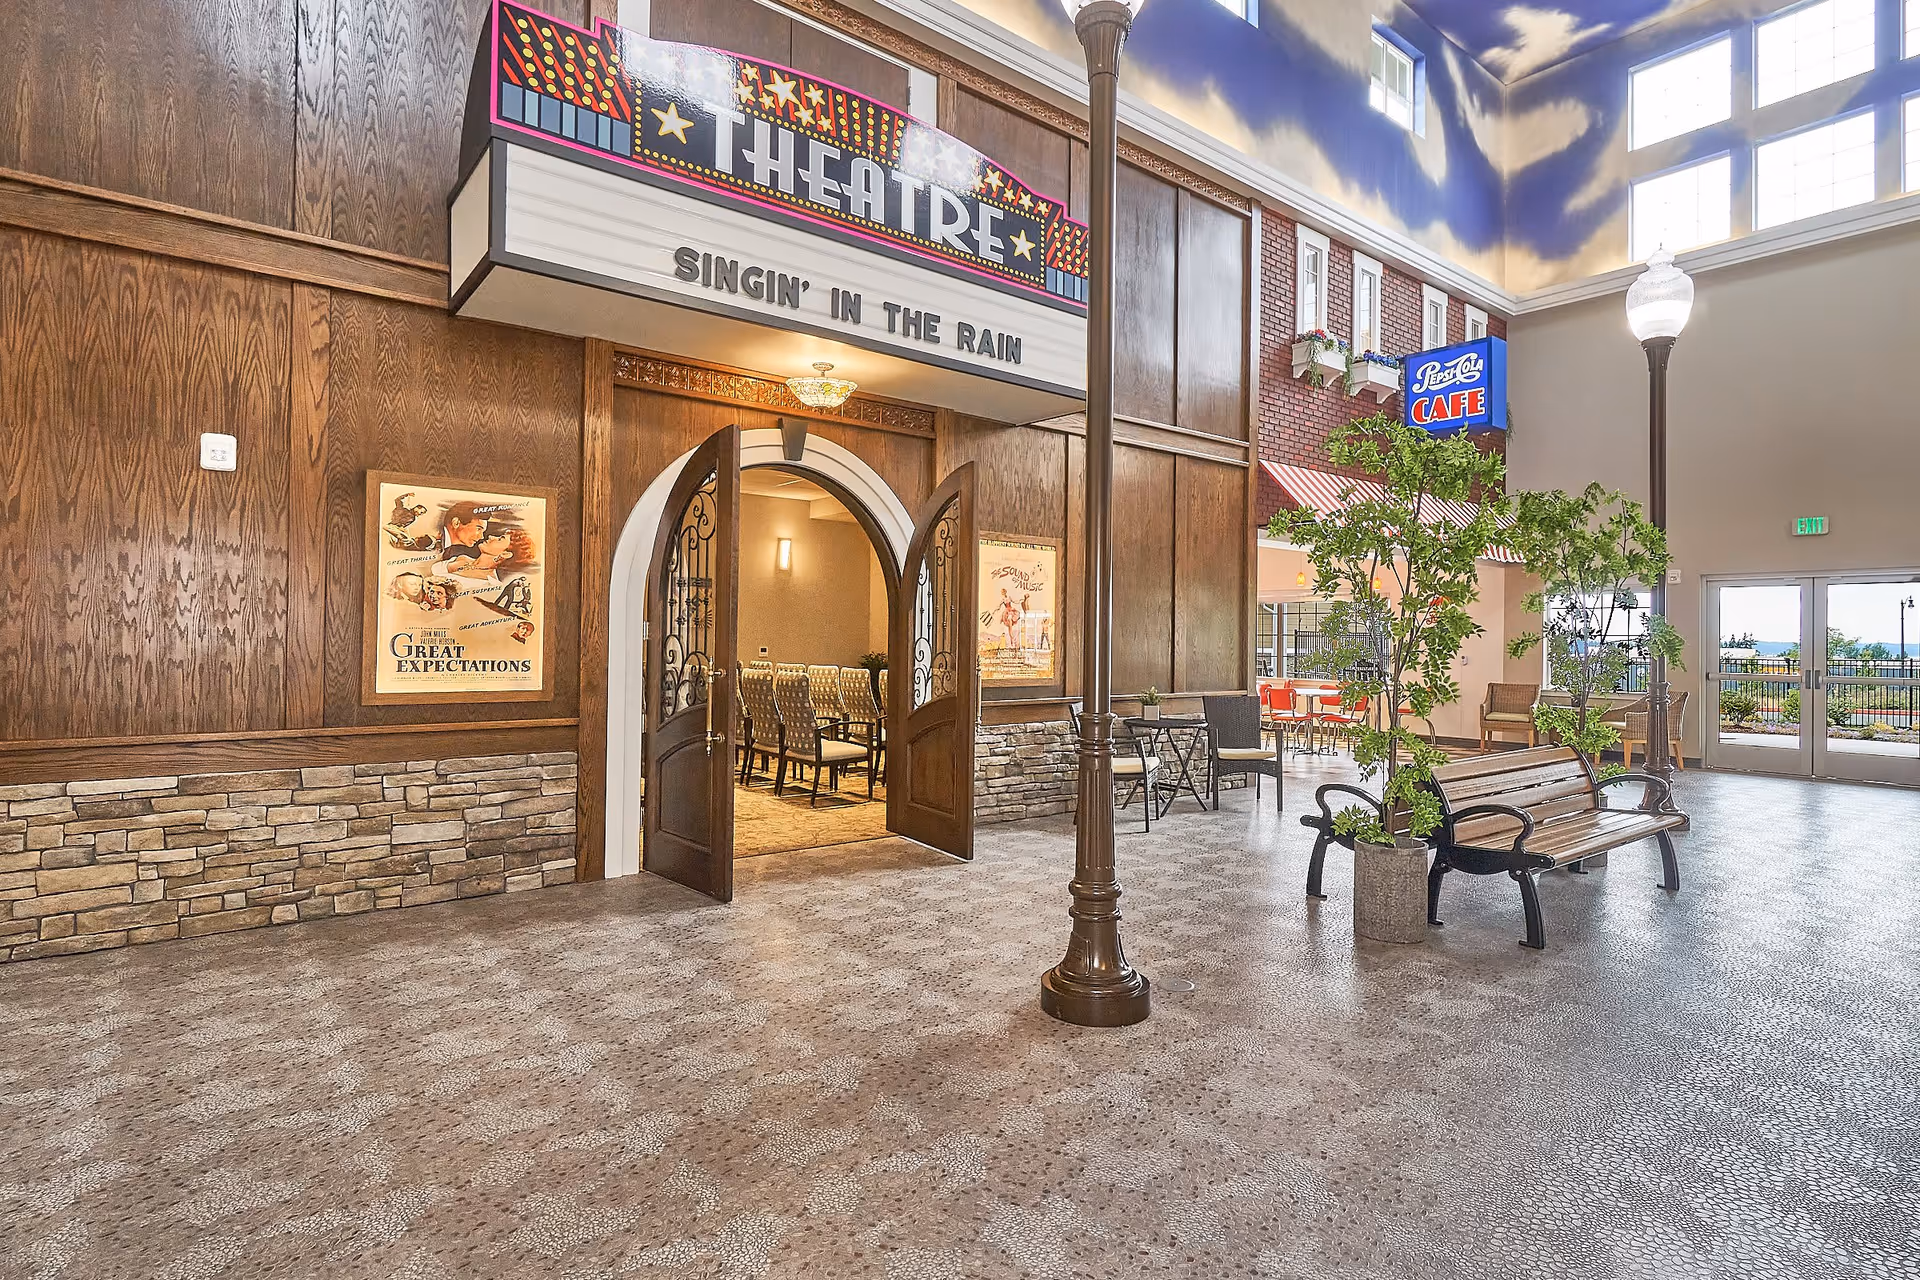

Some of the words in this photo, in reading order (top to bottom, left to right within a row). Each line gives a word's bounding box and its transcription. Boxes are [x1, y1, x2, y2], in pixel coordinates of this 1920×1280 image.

[703, 102, 1005, 264] THEATRE
[673, 246, 810, 309] SINGIN'
[830, 287, 862, 324] IN
[883, 301, 941, 344] THE
[957, 321, 1023, 365] RAIN
[1411, 387, 1485, 424] CAFE
[473, 506, 496, 514] GREAT
[498, 501, 530, 511] ROMANCE
[1797, 516, 1824, 535] EXIT
[387, 558, 409, 566] GREAT
[410, 555, 437, 563] THRILLS
[999, 565, 1030, 582] SOUND
[450, 590, 470, 599] GREAT
[472, 586, 502, 596] SUSPENSE
[1015, 580, 1044, 592] MUSIC
[458, 623, 479, 631] GREAT
[389, 632, 466, 659] GREAT
[396, 659, 532, 673] EXPECTATIONS
